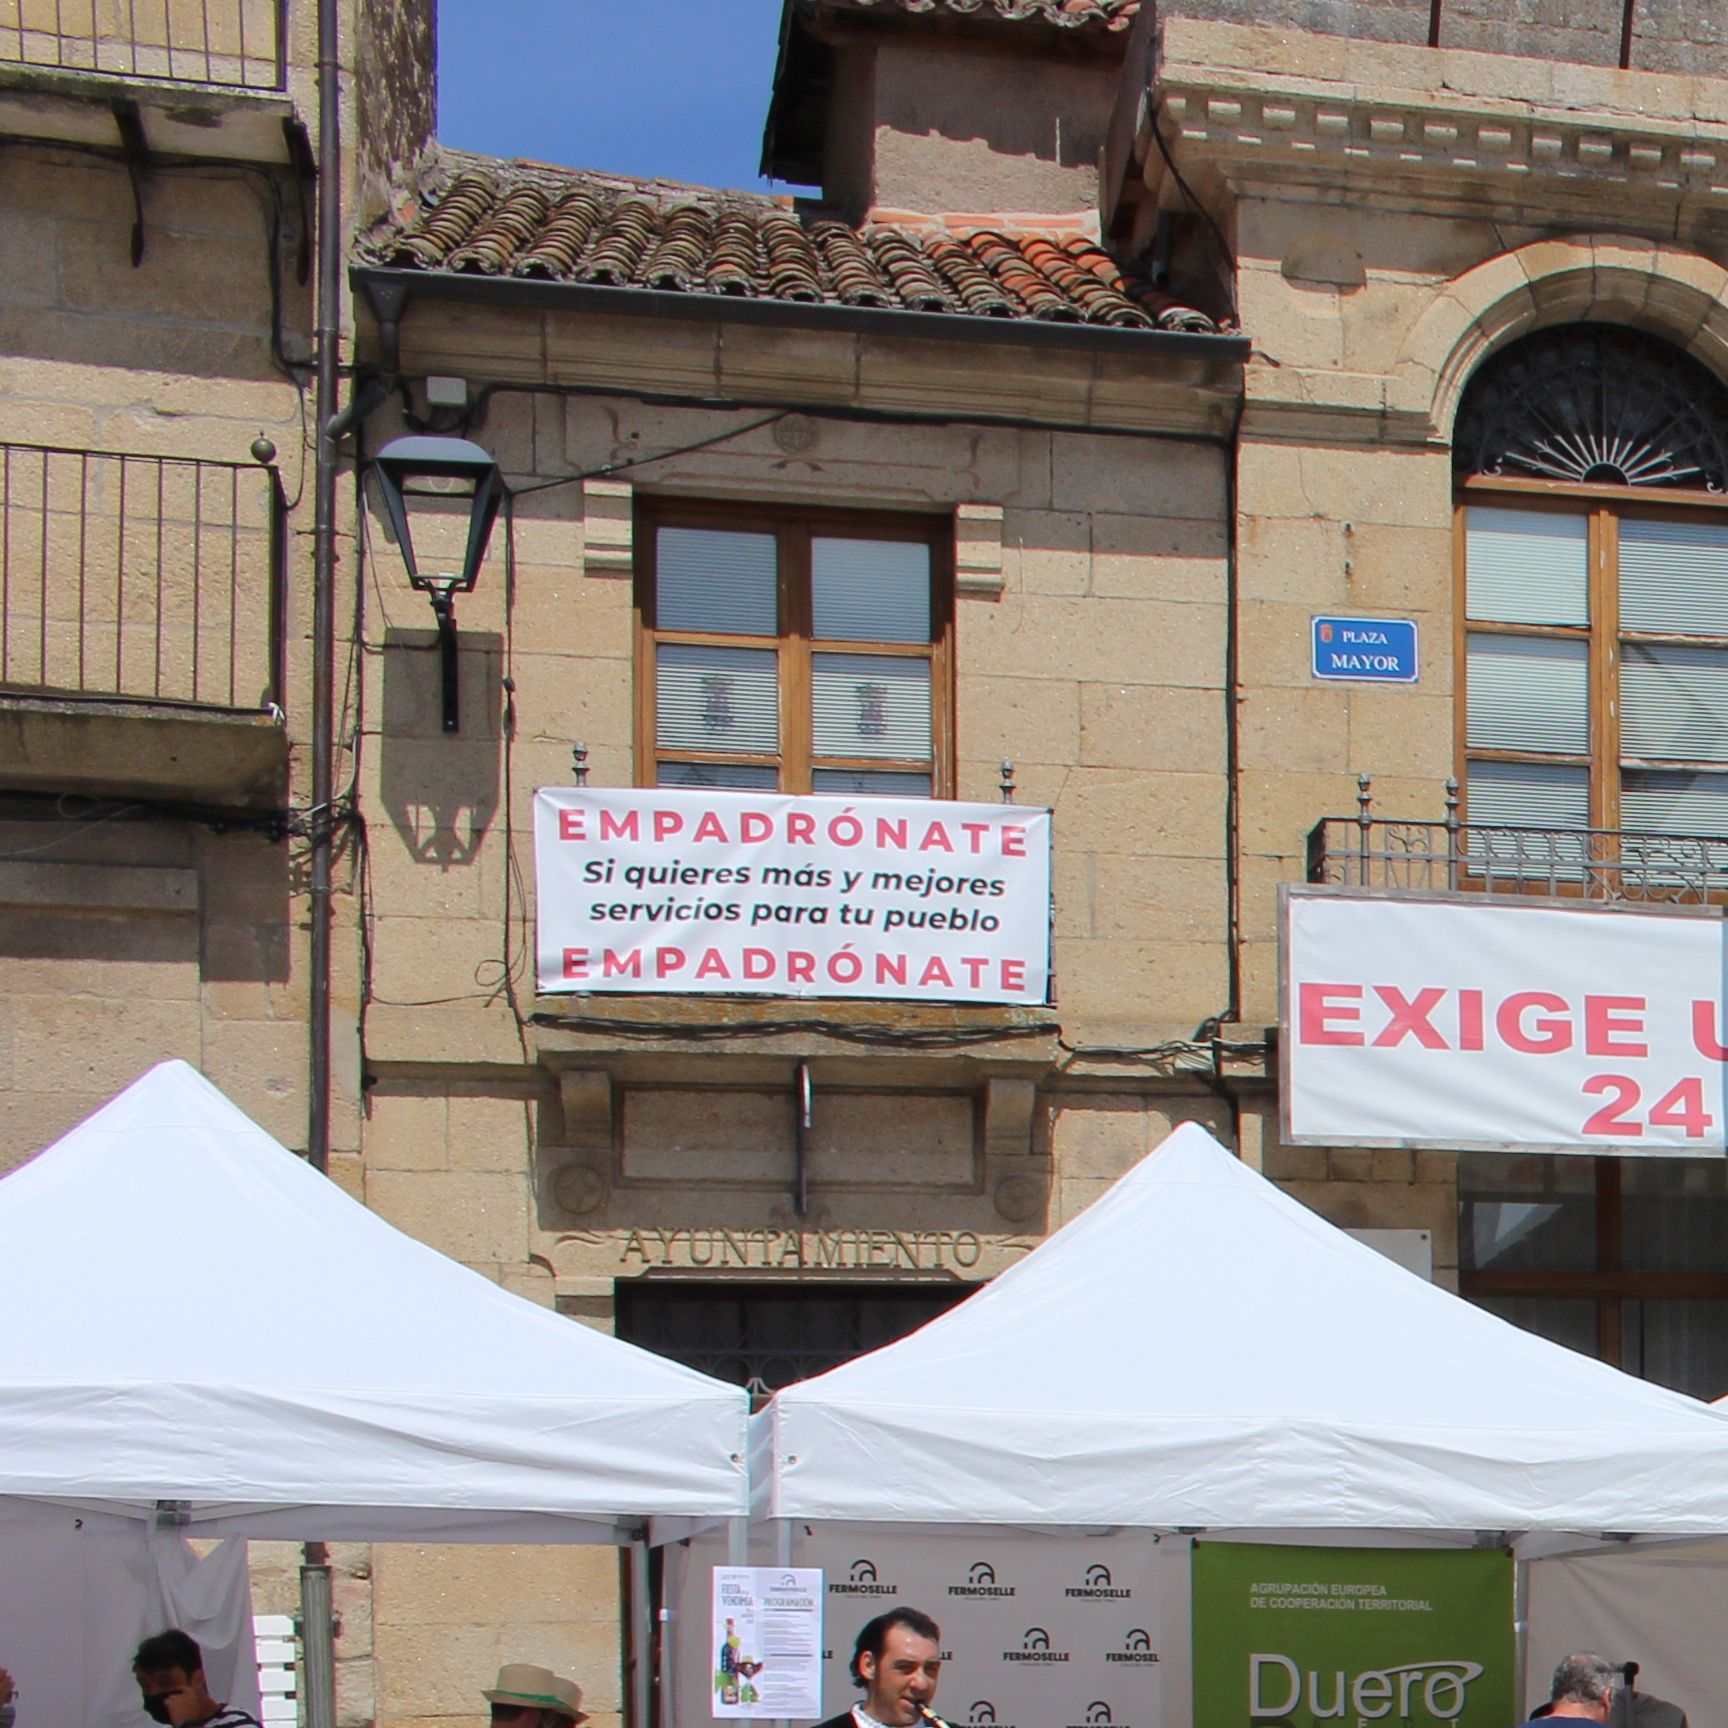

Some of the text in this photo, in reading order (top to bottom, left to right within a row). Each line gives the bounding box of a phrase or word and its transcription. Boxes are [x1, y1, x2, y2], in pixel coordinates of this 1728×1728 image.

[1342, 631, 1388, 645] PLAZA
[1331, 653, 1400, 671] MAYOR
[558, 807, 1027, 857] EMPADRÓNATE
[583, 858, 1006, 897] Si quieres más y mejores
[589, 896, 1000, 932] servicios para tu pueblo
[562, 943, 1026, 992] EMPADRÓNATE
[1298, 982, 1649, 1058] EXIGE
[1580, 1074, 1714, 1138] 24
[829, 1583, 898, 1595] FERMOSELLE
[949, 1585, 1016, 1597] FERMOSELLE
[1065, 1588, 1131, 1599] FERMOSELLE
[1250, 1582, 1387, 1597] AGRUPACIÓN EUROPEA
[1250, 1597, 1433, 1611] DE COOPERACIÓN TERRITORIAL
[1003, 1651, 1070, 1663] FERMOSELLE
[1106, 1652, 1160, 1663] FERMOSEL
[1249, 1653, 1466, 1720] Duero
